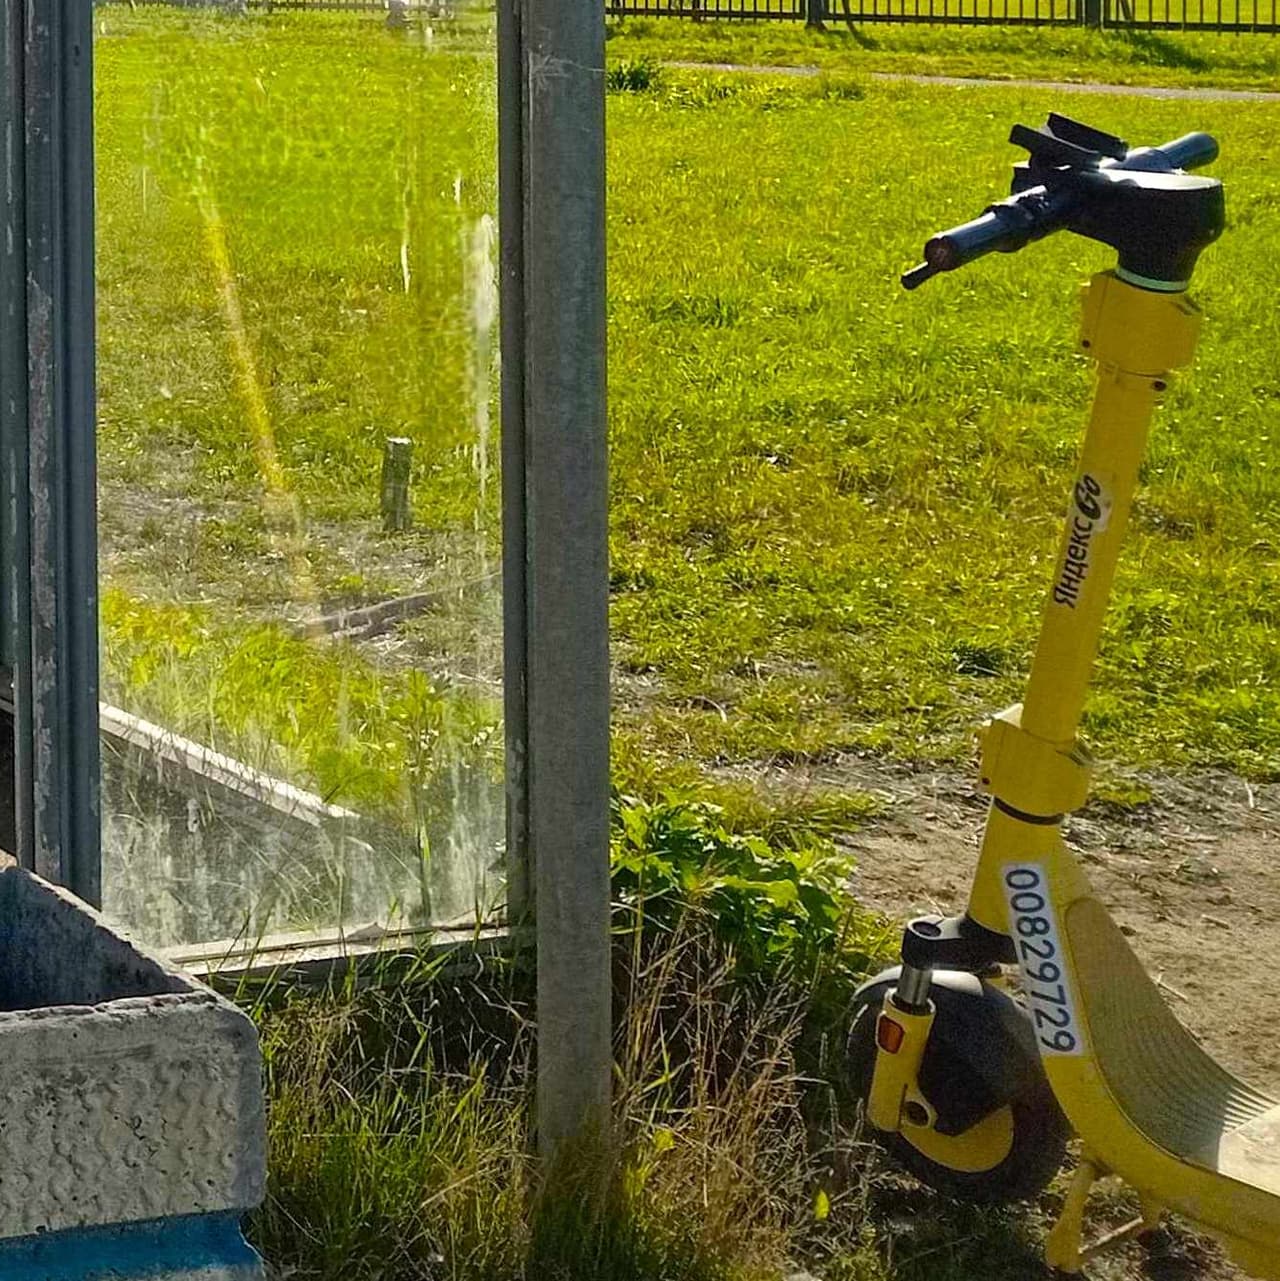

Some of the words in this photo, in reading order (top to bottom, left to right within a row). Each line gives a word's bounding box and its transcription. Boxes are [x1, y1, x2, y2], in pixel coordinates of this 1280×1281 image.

[1054, 516, 1093, 609] Яндекс
[1074, 474, 1102, 520] Go
[1005, 868, 1076, 1052] 00829729
